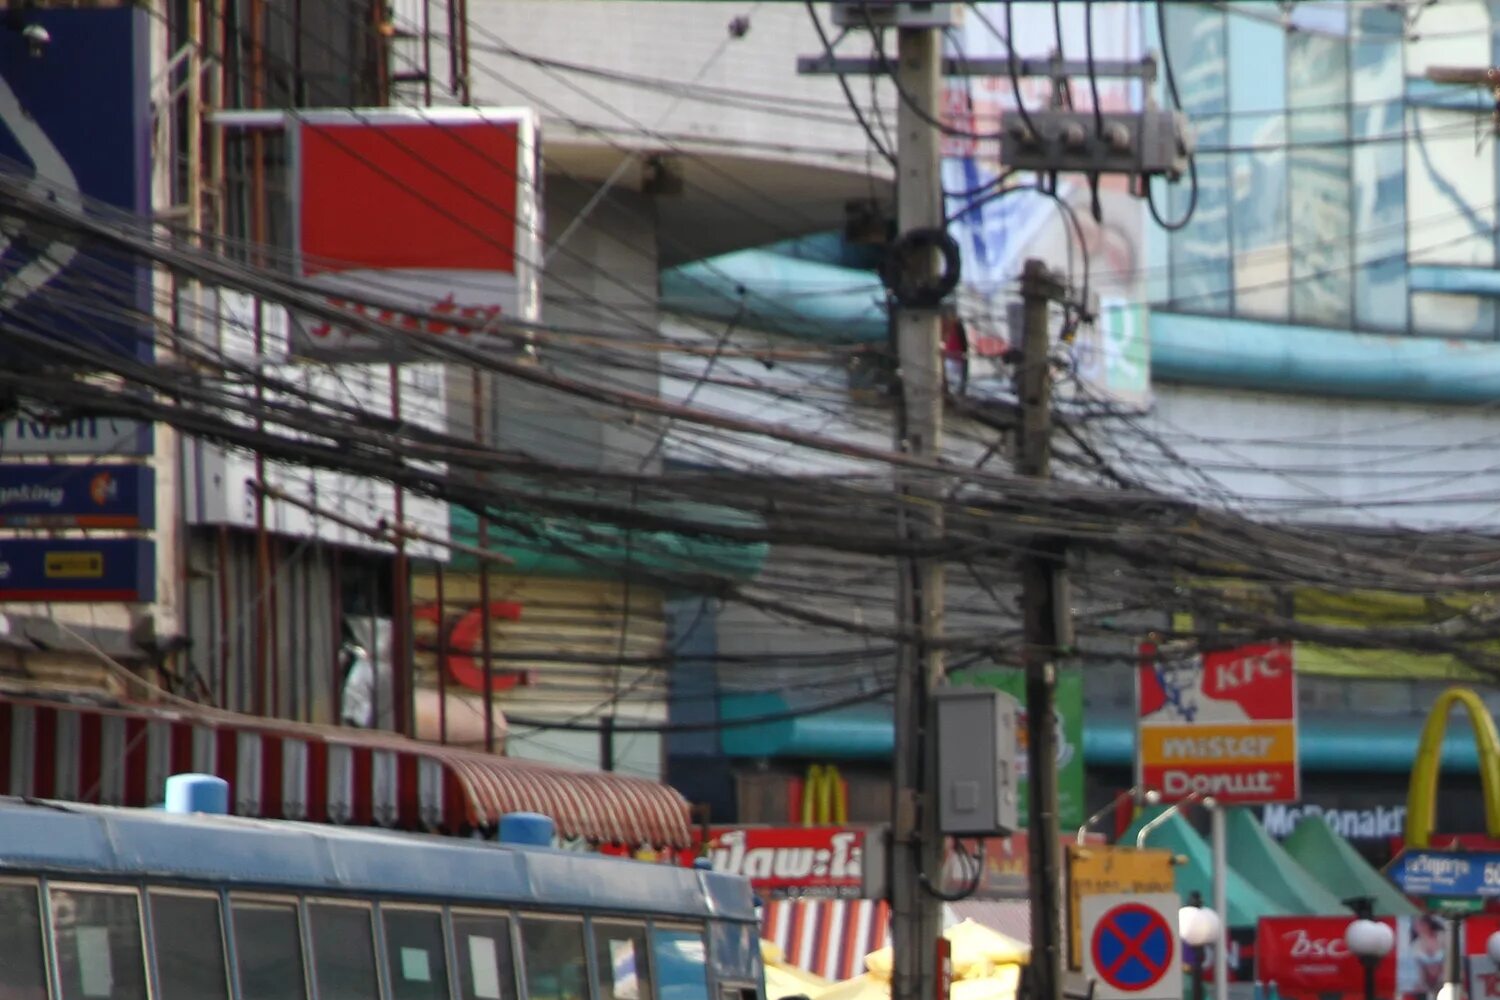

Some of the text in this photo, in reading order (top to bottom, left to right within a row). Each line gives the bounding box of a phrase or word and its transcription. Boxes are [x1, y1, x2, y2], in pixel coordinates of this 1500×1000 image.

[1215, 650, 1283, 692] KFC
[1163, 735, 1275, 759] mister
[1163, 770, 1275, 794] Donut
